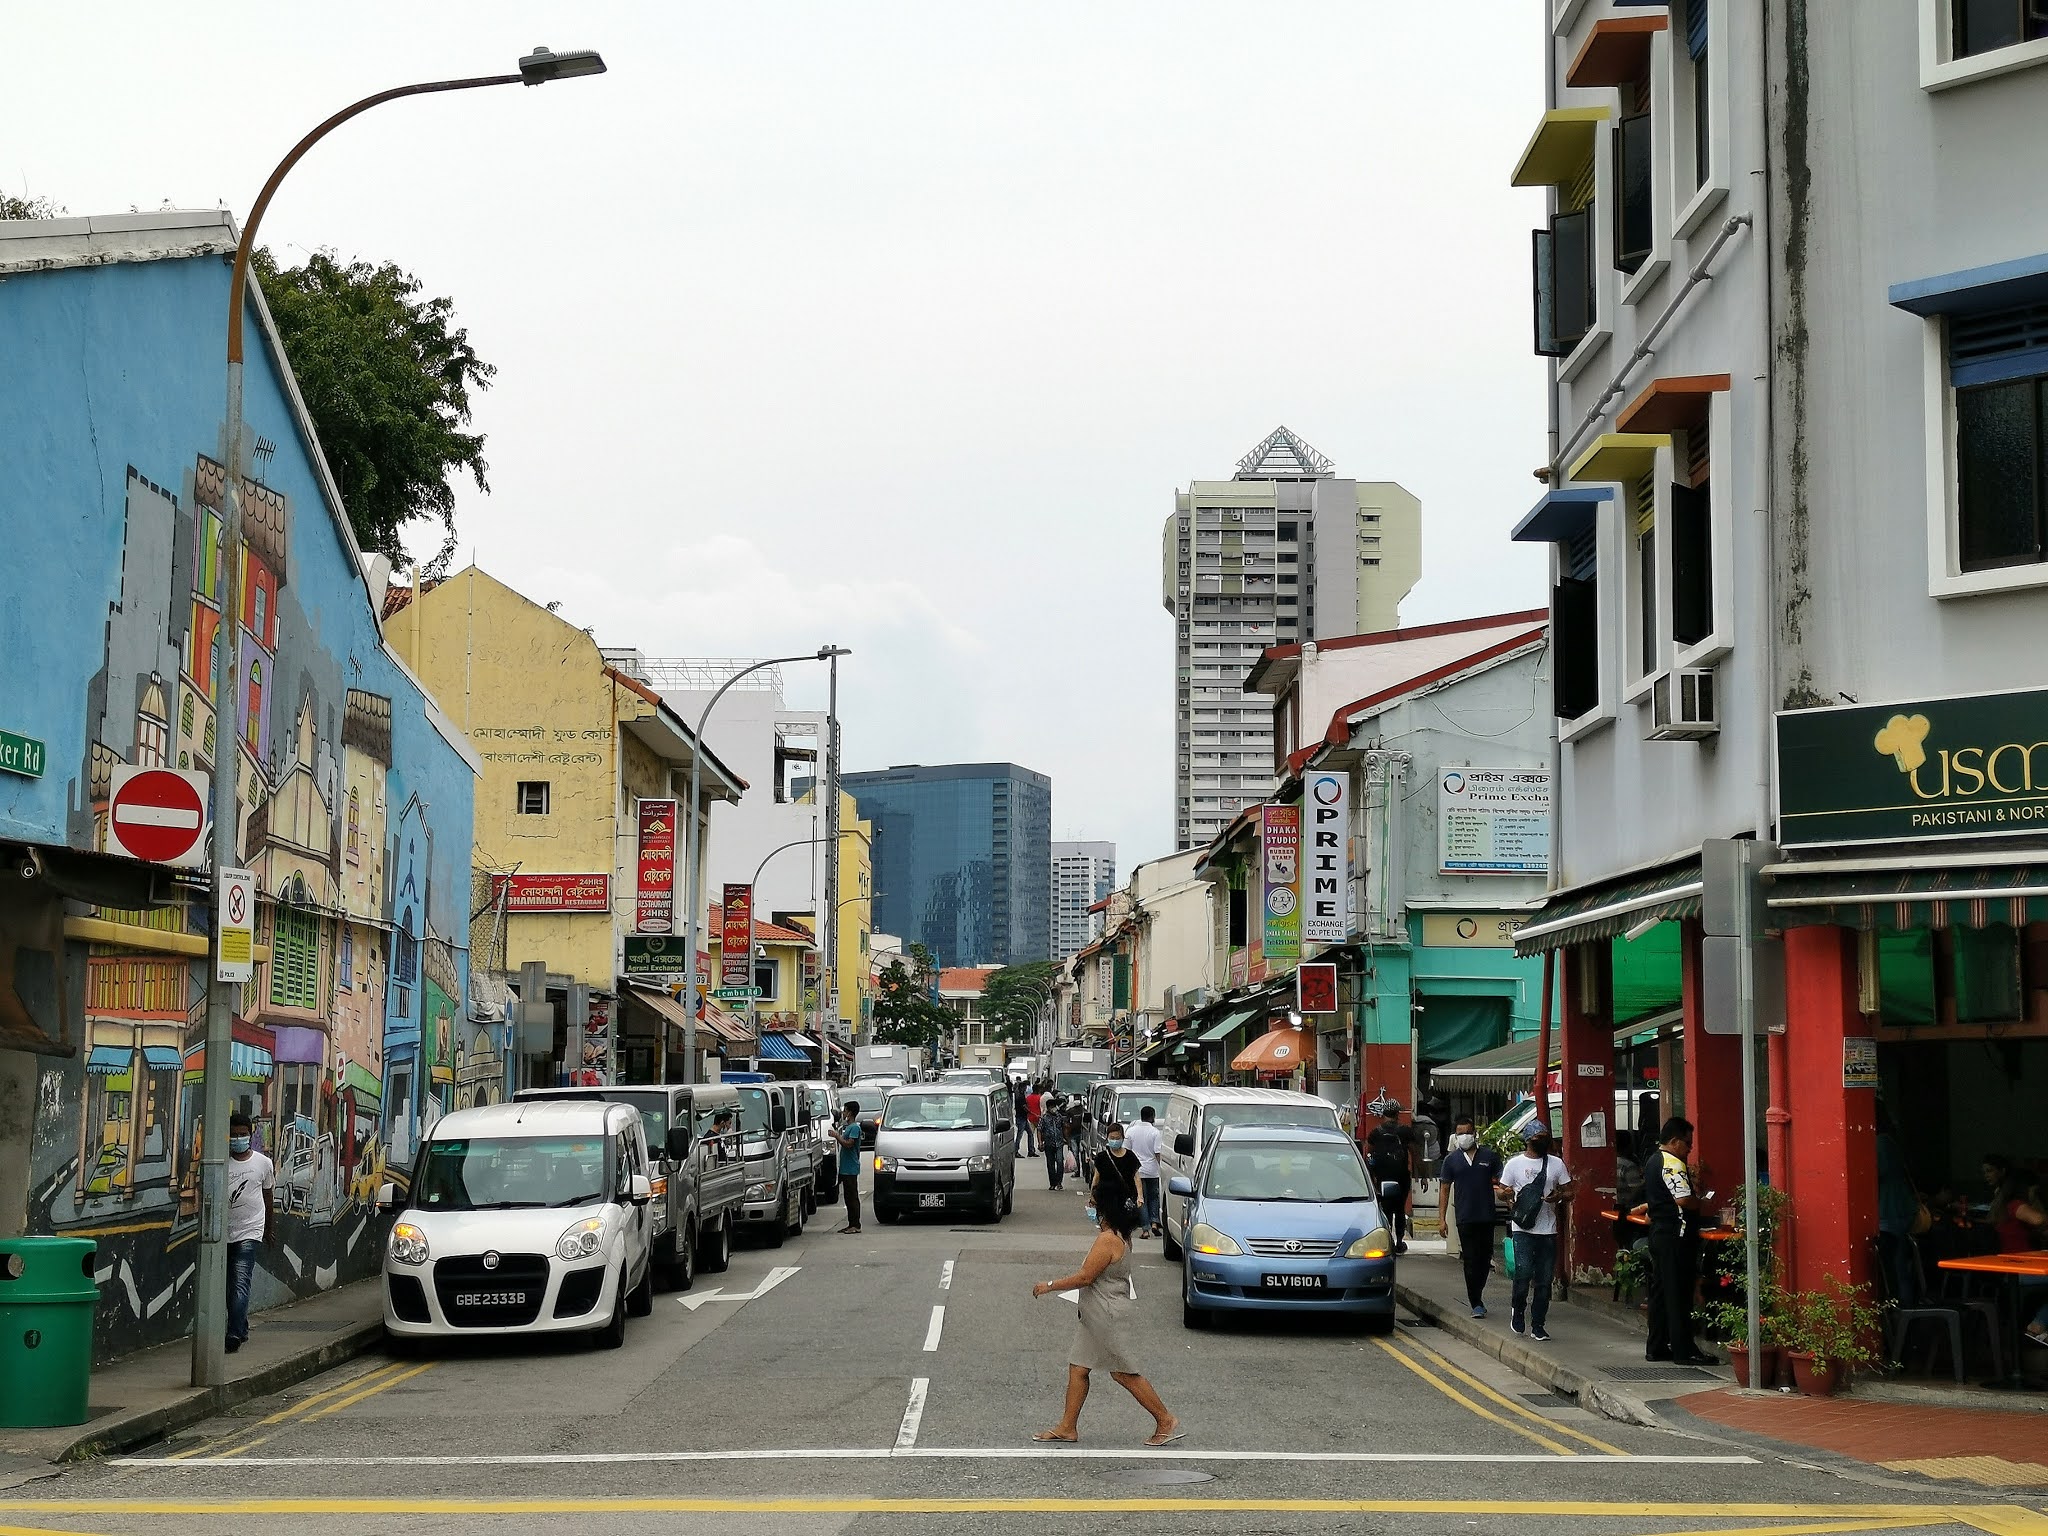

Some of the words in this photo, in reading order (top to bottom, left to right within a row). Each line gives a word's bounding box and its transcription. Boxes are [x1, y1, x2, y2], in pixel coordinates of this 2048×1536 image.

[24, 742, 40, 771] Rd
[1468, 772, 1505, 783] প্রাইম
[1469, 793, 1507, 801] Prime
[1912, 809, 1991, 826] PAKISTANI
[1995, 808, 2006, 821] &
[1267, 826, 1297, 834] DHAKA
[1266, 836, 1297, 844] STUDIO
[1314, 808, 1339, 917] PRIME
[580, 878, 604, 886] 24HRS
[508, 897, 562, 905] OHAMMADI
[641, 909, 669, 917] 24HRS
[1308, 920, 1344, 928] EXCHANGE
[717, 989, 745, 997] Lembu
[456, 1292, 526, 1306] GBE2333B
